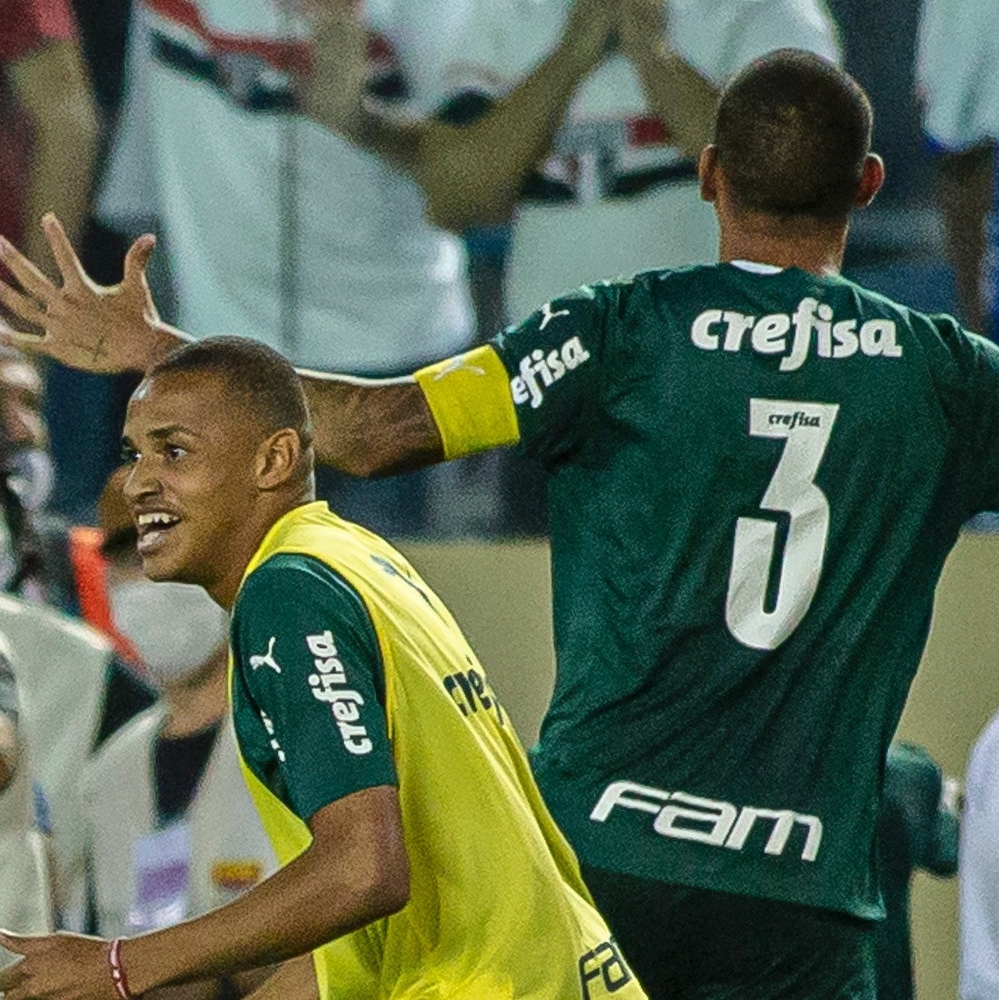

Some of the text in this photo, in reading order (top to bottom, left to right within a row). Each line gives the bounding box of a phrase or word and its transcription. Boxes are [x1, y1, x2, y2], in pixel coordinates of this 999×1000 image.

[691, 297, 903, 372] crefisa
[768, 412, 821, 430] crefisa
[725, 398, 840, 650] 3
[306, 630, 373, 755] crefisa
